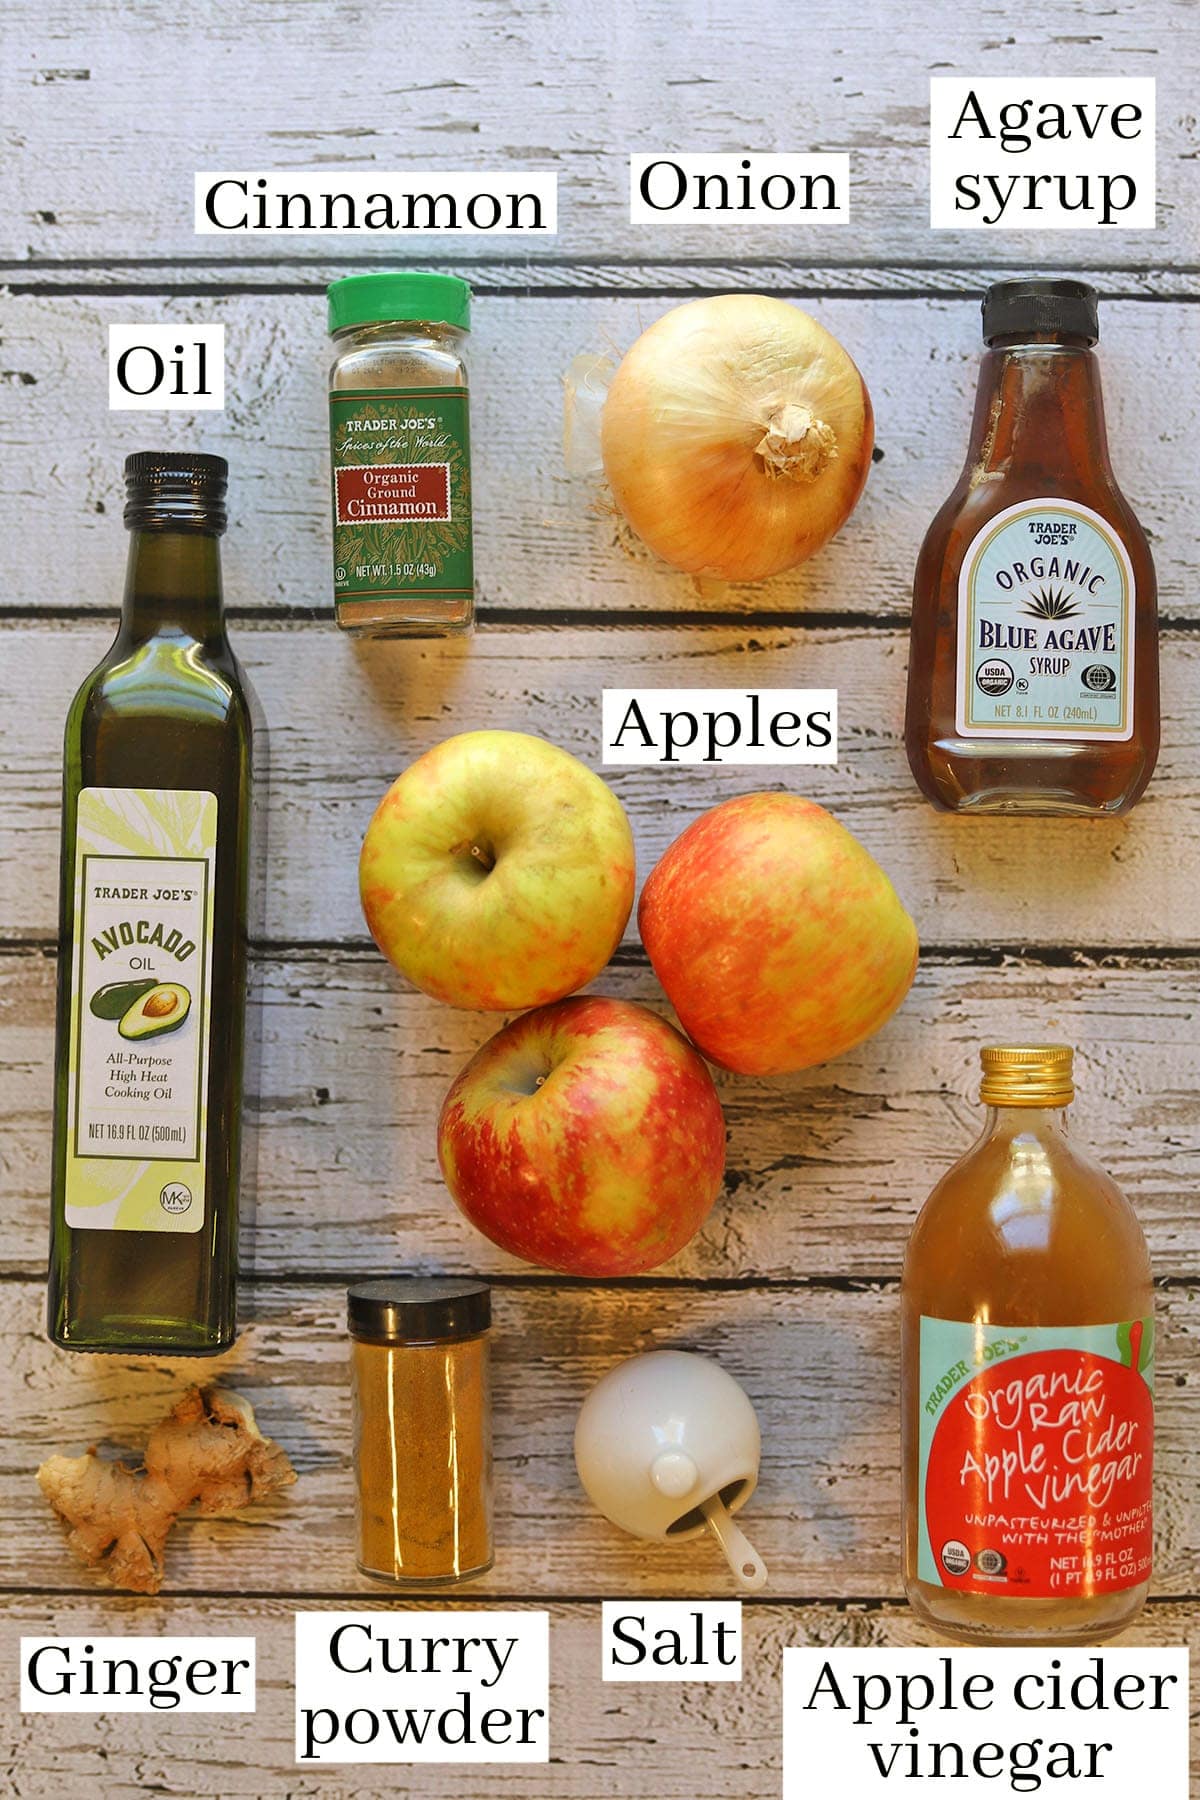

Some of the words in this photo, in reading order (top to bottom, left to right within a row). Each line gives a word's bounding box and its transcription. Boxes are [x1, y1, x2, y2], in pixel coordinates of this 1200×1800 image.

[346, 419, 397, 432] TRADER
[400, 418, 436, 430] JOE'S
[336, 437, 374, 457] Spices
[375, 435, 393, 455] of
[389, 435, 409, 449] the
[415, 434, 452, 448] World
[363, 470, 419, 486] Organic
[367, 485, 416, 499] Ground
[347, 499, 437, 517] Cinnamon
[1028, 522, 1077, 534] TRADER
[1034, 534, 1069, 545] JOE'S
[356, 565, 370, 577] NET
[372, 564, 387, 577] WT.
[389, 564, 401, 576] 1.5
[403, 564, 414, 576] OZ
[416, 563, 437, 577] (43g)
[995, 556, 1105, 595] ORGANIC
[979, 618, 1038, 649] BLUE
[1043, 622, 1116, 652] AGAVE
[984, 668, 1006, 677] USDA
[1029, 656, 1071, 676] SYRUP
[994, 705, 1011, 717] NET
[1015, 705, 1028, 718] 8.1
[1033, 705, 1043, 718] FL
[1047, 706, 1059, 718] OZ
[1063, 706, 1098, 721] (240mL)
[94, 887, 148, 899] TRADER
[153, 889, 193, 901] JOE'S
[91, 920, 196, 962] AVOCADO
[129, 956, 155, 971] OIL
[106, 1052, 173, 1067] All-Purpose
[110, 1069, 137, 1083] High
[141, 1070, 168, 1083] Heat
[104, 1086, 150, 1101] Cooking
[153, 1087, 172, 1099] Oil
[88, 1123, 104, 1139] NET
[107, 1124, 125, 1140] 16.9
[126, 1124, 136, 1140] FL
[138, 1125, 150, 1141] OZ
[151, 1125, 186, 1144] (500mL)
[162, 1191, 183, 1205] MK
[925, 1359, 970, 1416] TRADER
[964, 1356, 1104, 1430] Organic
[1028, 1394, 1106, 1432] Raw
[959, 1429, 1047, 1504] Apple
[1062, 1413, 1139, 1465] Cider
[1024, 1451, 1143, 1511] Vinegar
[965, 1513, 1096, 1531] UNPASTEURIZED
[1102, 1512, 1111, 1527] &
[1002, 1531, 1049, 1545] WITH
[1054, 1530, 1087, 1545] THE
[947, 1547, 965, 1557] USDA
[1050, 1556, 1079, 1570] NET
[1105, 1552, 1117, 1565] FL
[1118, 1547, 1133, 1562] OZ
[1049, 1572, 1060, 1589] (1
[1065, 1571, 1082, 1585] PT
[1105, 1567, 1117, 1580] FL
[1119, 1561, 1137, 1577] OZ)
